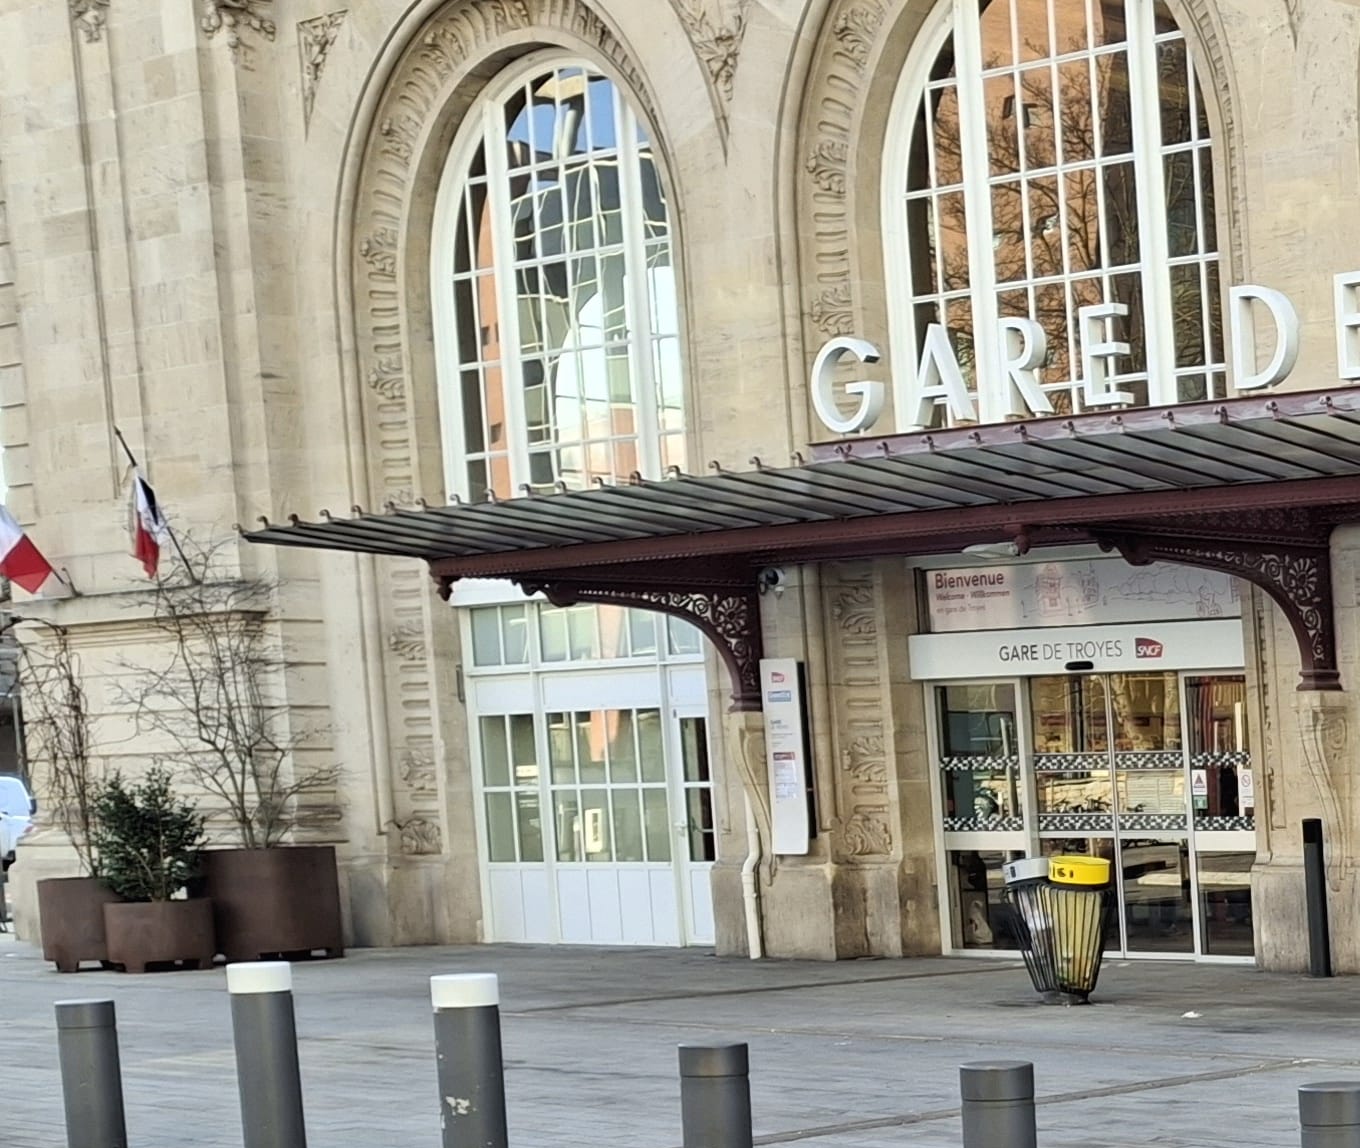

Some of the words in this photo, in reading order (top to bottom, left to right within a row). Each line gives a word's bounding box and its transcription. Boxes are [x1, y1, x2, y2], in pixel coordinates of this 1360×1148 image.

[811, 302, 1135, 435] GARE
[935, 572, 1005, 589] Bienvenue
[999, 644, 1039, 661] GARE
[1043, 642, 1063, 660] DE
[1066, 639, 1123, 659] TROYES
[1136, 644, 1162, 656] SNCF
